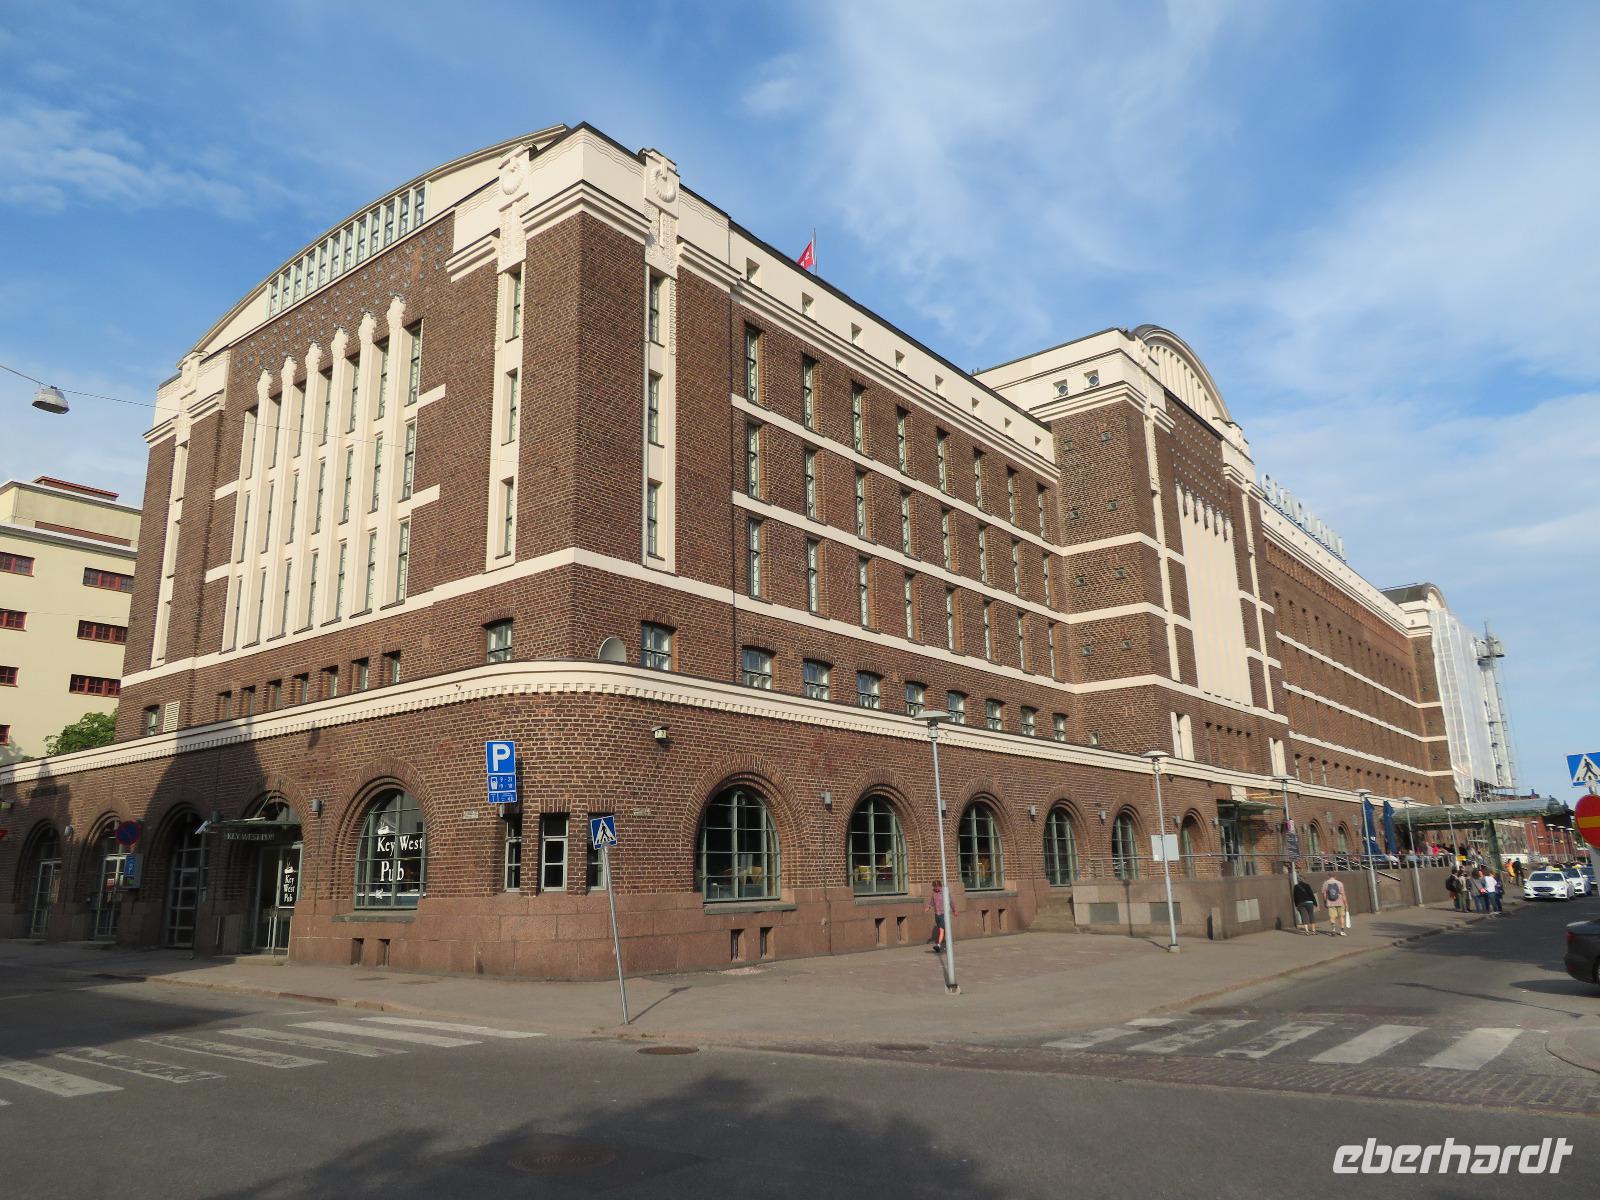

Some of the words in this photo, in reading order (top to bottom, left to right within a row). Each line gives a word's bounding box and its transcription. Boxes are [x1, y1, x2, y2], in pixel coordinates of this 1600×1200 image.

[493, 744, 510, 771] P
[377, 836, 396, 857] Key
[399, 835, 423, 851] West
[380, 861, 405, 882] Pub
[283, 883, 296, 893] West
[284, 874, 295, 887] Key
[283, 893, 293, 903] Pub
